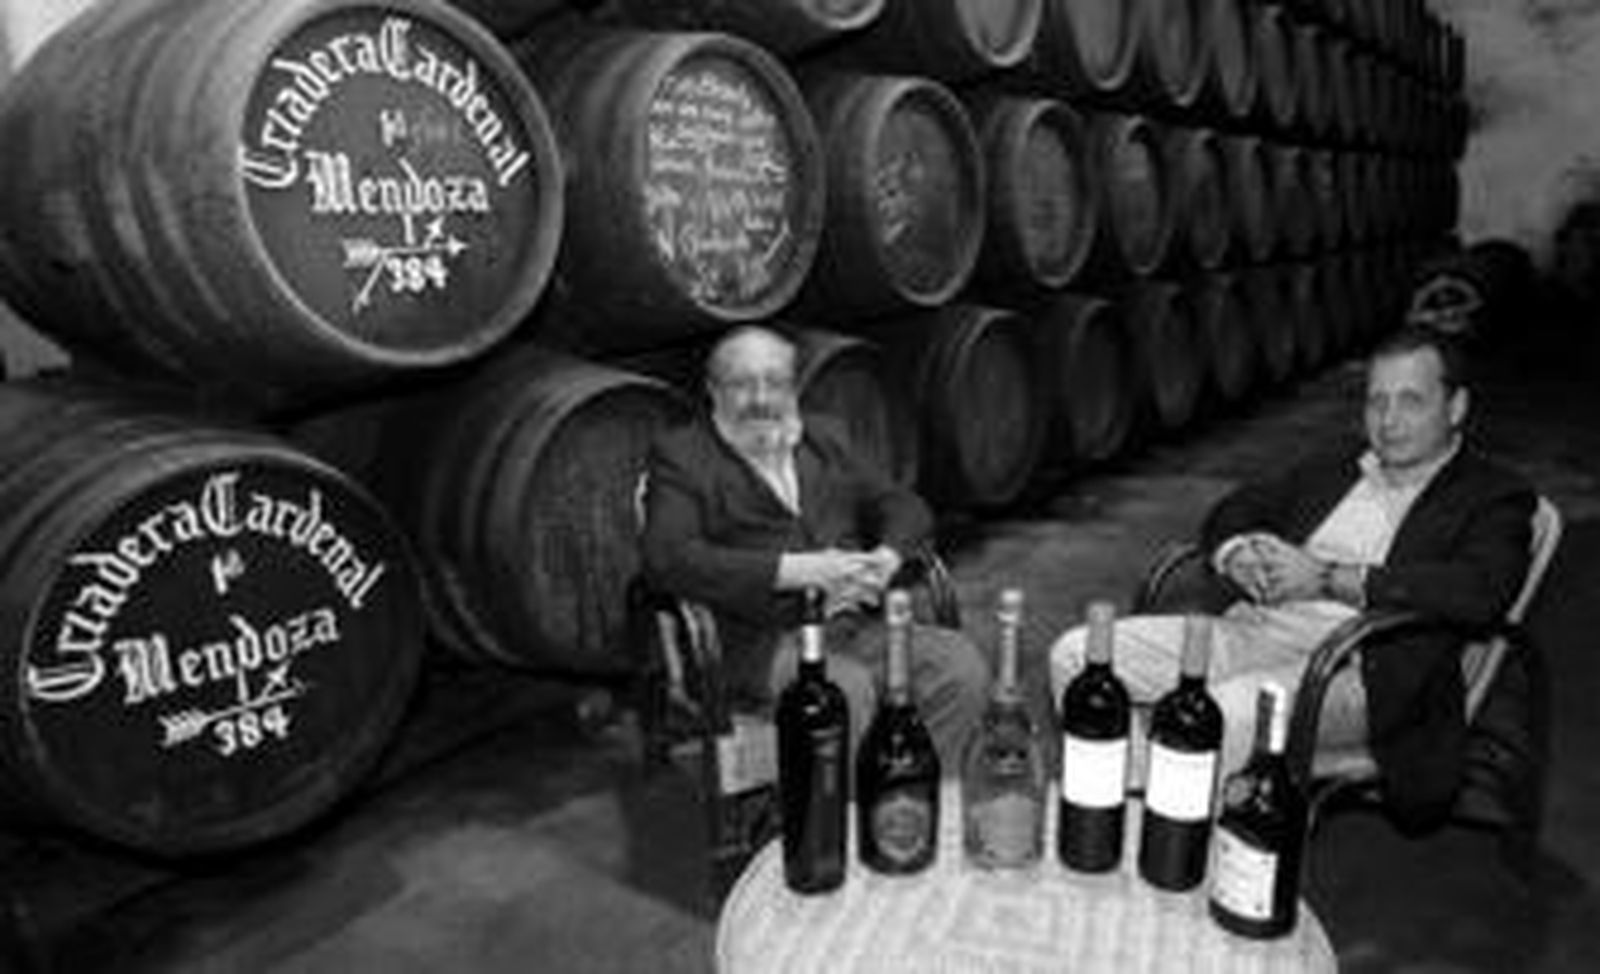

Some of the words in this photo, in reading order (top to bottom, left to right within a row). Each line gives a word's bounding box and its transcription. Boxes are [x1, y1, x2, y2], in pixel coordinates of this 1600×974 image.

[304, 151, 491, 214] Mendoza
[385, 256, 448, 292] 384
[114, 607, 341, 704] Mendoza
[213, 705, 291, 757] 384
